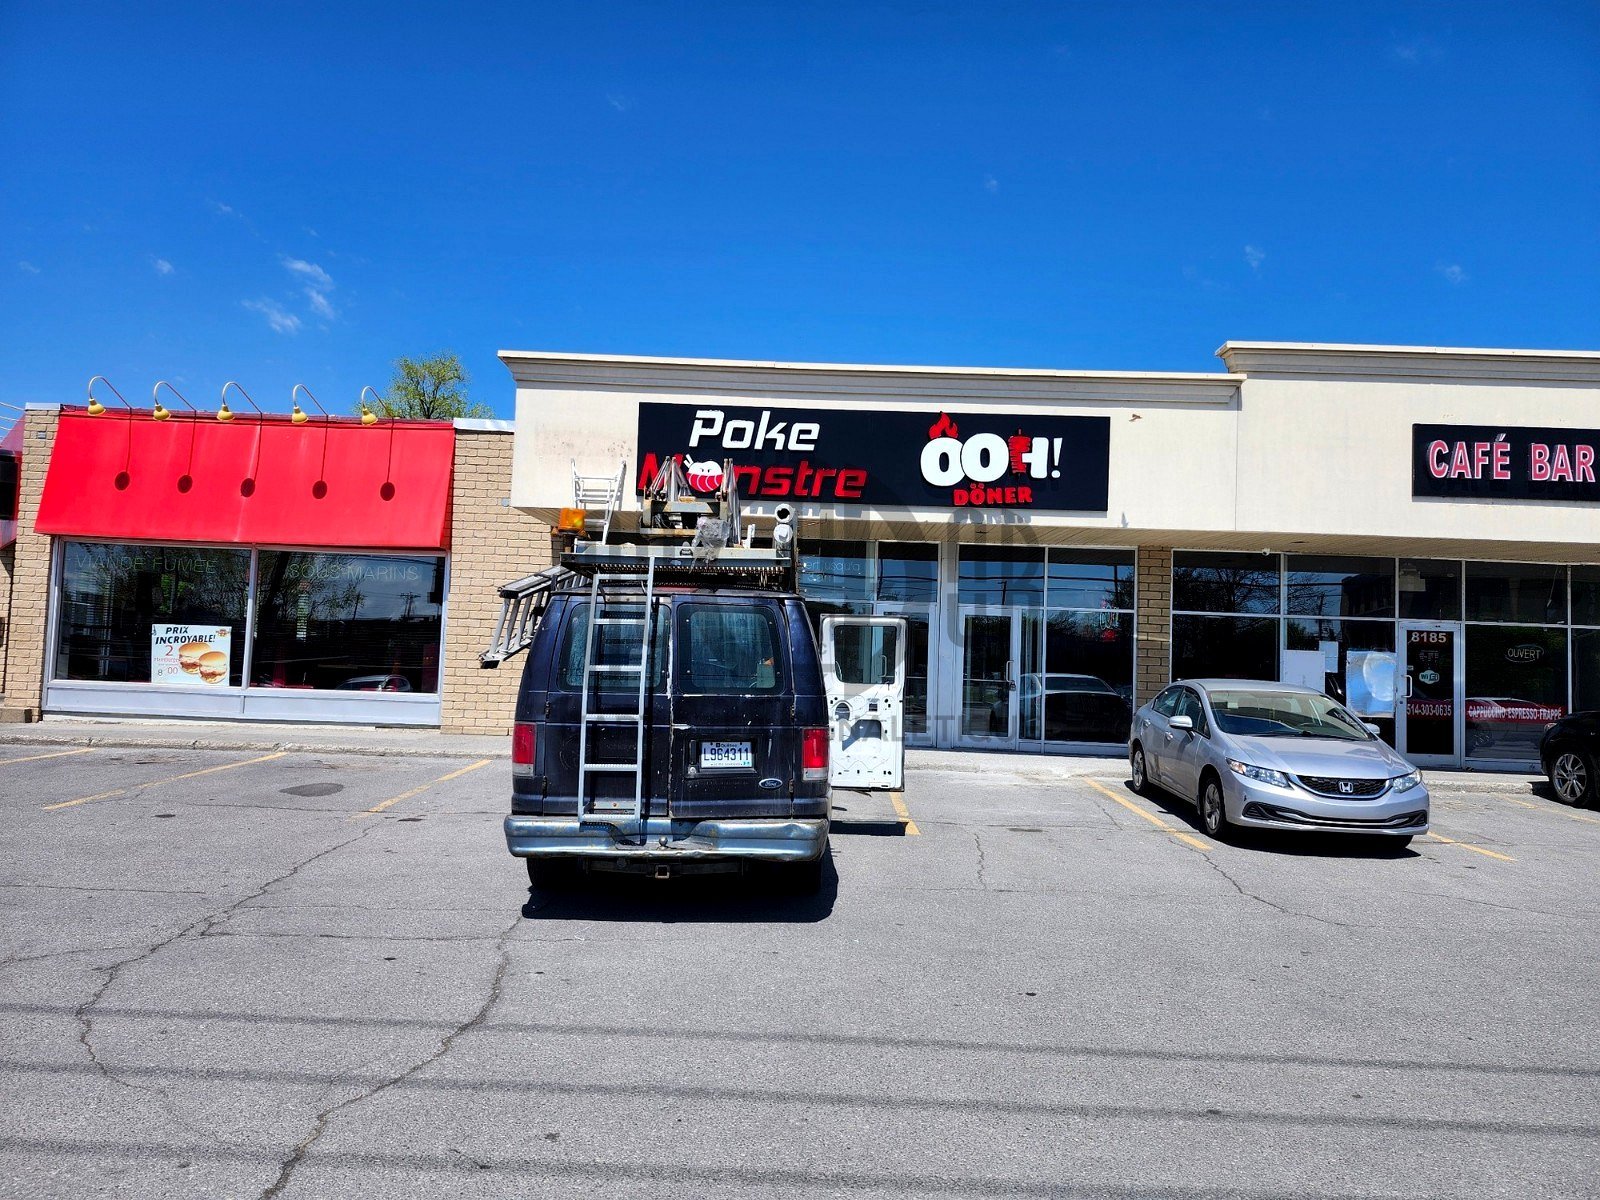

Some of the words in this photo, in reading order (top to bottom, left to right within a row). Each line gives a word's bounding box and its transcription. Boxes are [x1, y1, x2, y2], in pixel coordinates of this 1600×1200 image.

[688, 409, 821, 451] Poke
[1427, 433, 1511, 480] CAFÉ
[1531, 443, 1596, 482] BAR
[76, 554, 146, 571] VIANDE
[165, 626, 189, 635] PRIX
[155, 634, 216, 645] INCROYABLE!
[1411, 631, 1447, 643] 8185
[165, 645, 174, 657] 2
[1507, 647, 1541, 659] OUVERT
[1406, 703, 1452, 716] 514-303-0635
[703, 747, 749, 761] L964311
